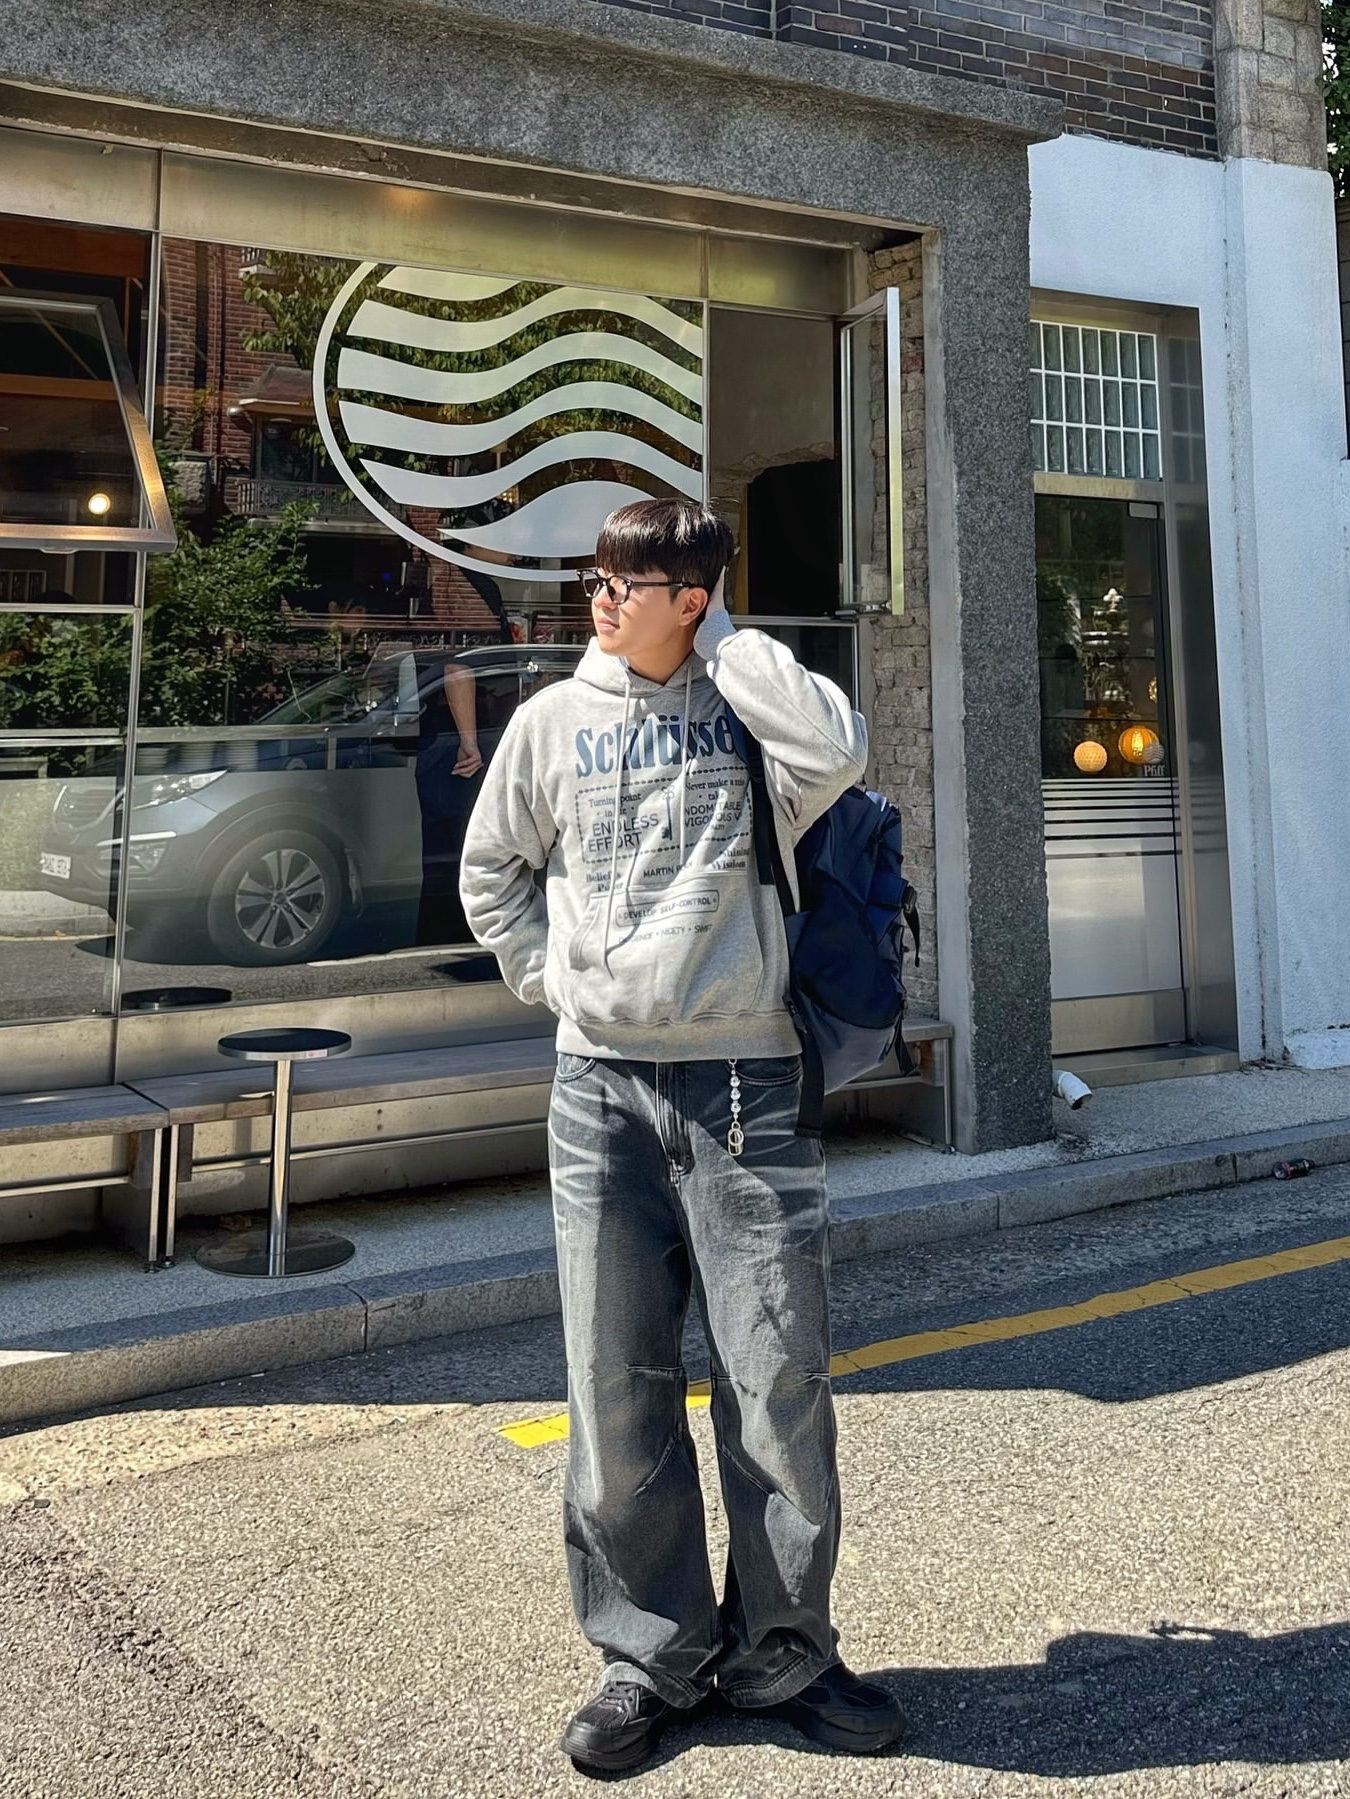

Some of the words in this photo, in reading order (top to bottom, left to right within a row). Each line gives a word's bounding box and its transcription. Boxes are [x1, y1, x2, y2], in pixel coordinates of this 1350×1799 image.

[707, 778, 728, 788] make
[620, 793, 642, 808] point
[643, 865, 674, 879] MARTIN
[597, 882, 624, 892] Poer
[623, 908, 656, 920] DEVELOP
[660, 897, 711, 914] SELF-CONTROL
